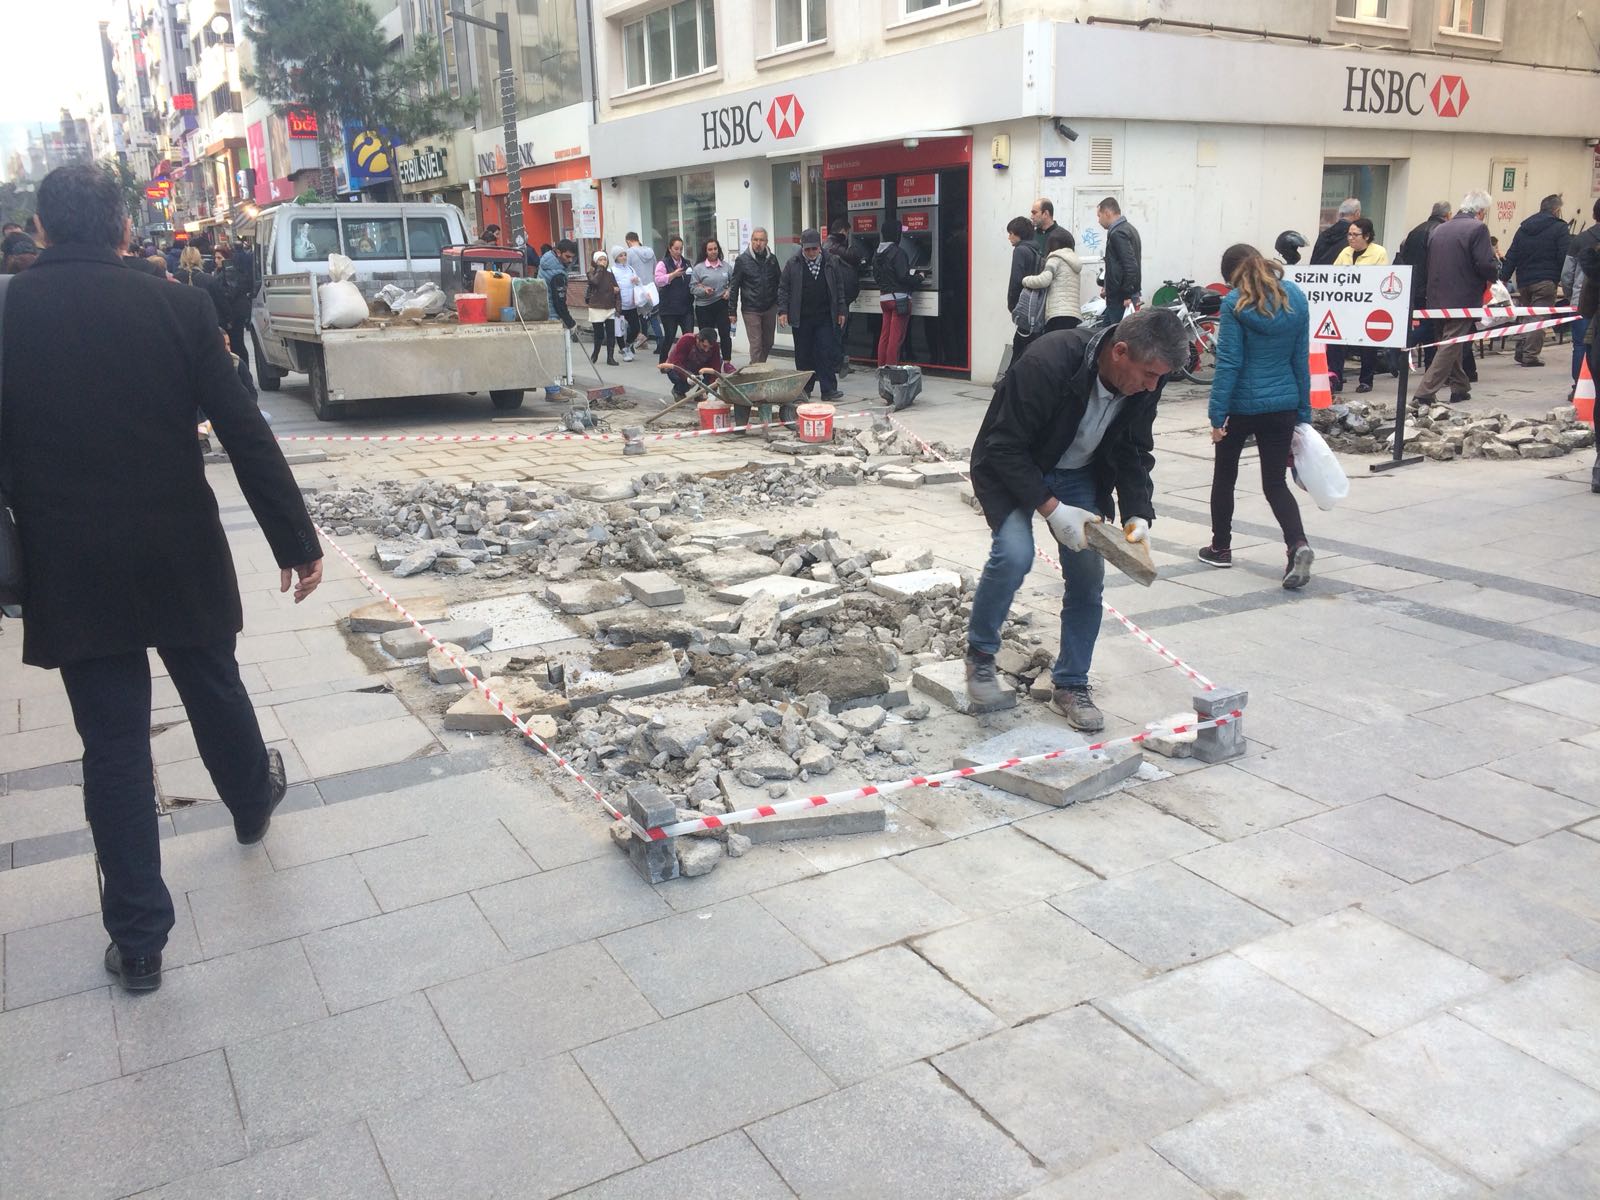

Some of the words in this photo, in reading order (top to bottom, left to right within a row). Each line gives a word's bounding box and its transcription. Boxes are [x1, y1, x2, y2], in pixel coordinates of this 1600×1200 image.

[1343, 66, 1426, 116] HSBC
[701, 100, 763, 151] HSBC
[477, 152, 496, 176] ING
[519, 141, 536, 167] NK
[852, 183, 863, 192] ATM
[904, 178, 915, 187] ATM
[1496, 200, 1517, 210] YANGIN
[1307, 290, 1374, 304] IŞIYORUZ
